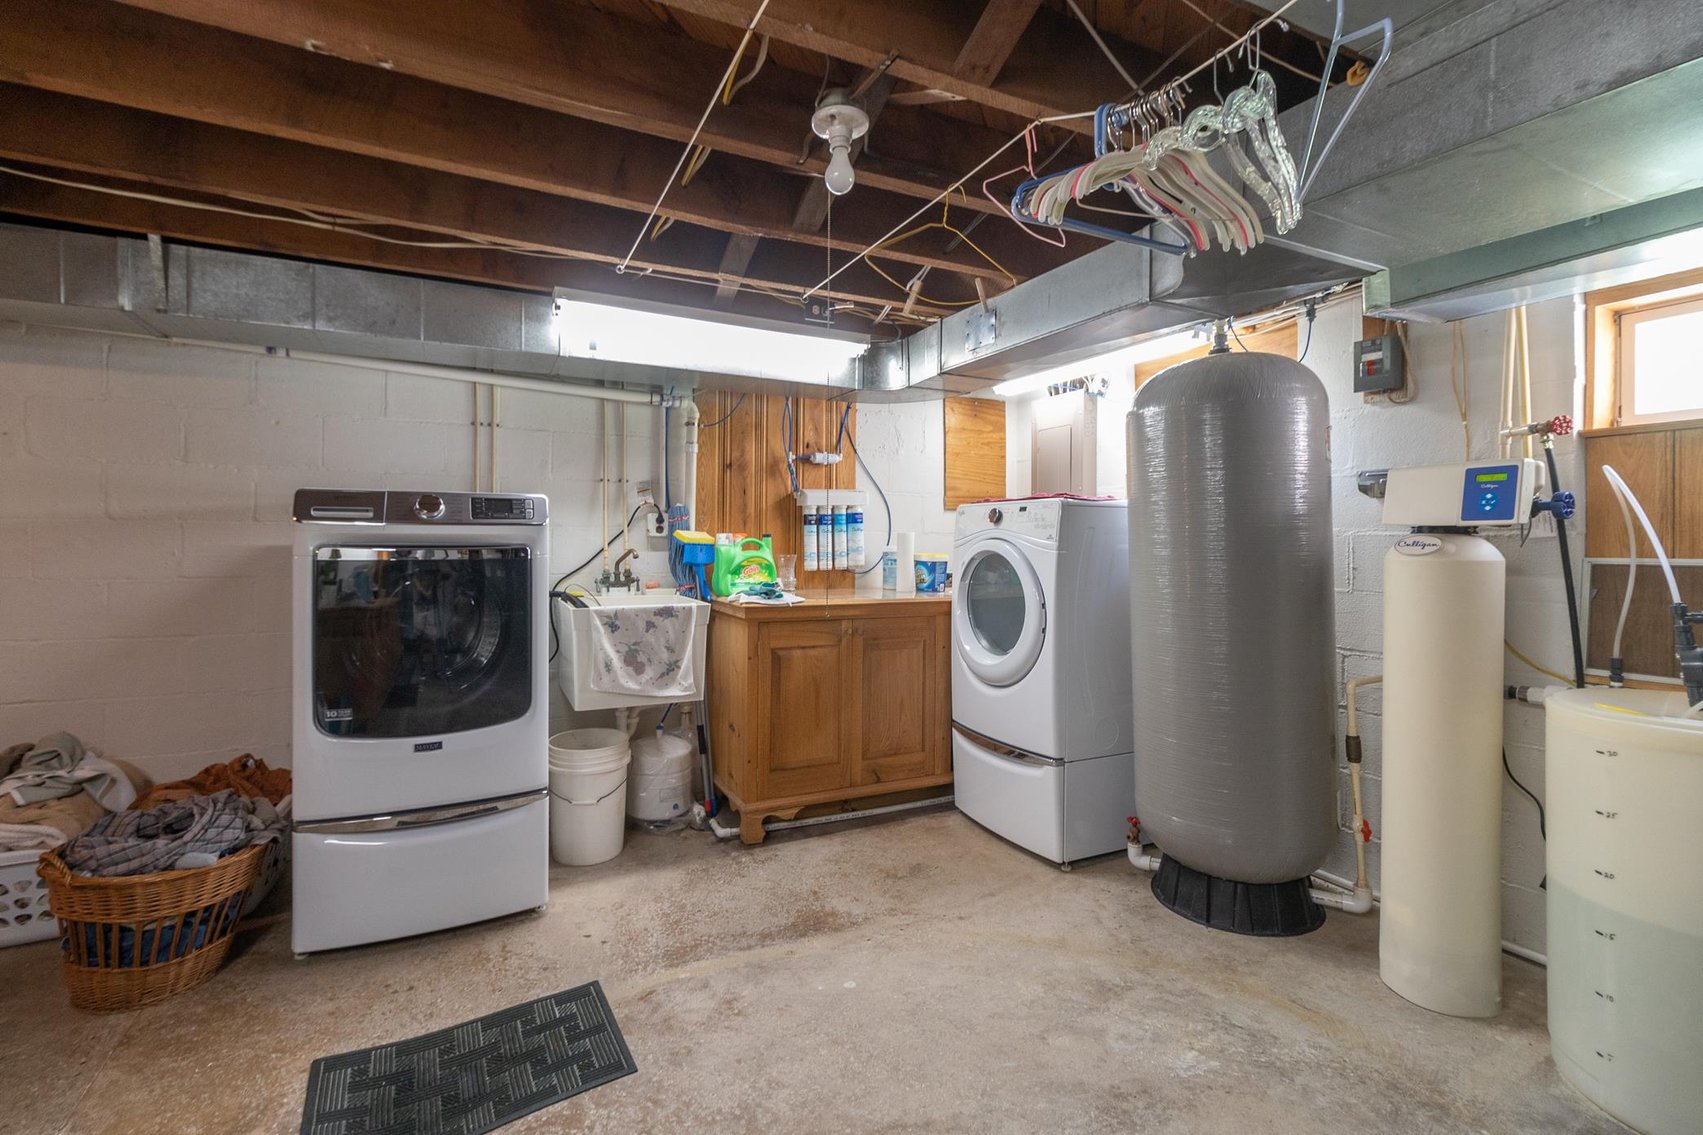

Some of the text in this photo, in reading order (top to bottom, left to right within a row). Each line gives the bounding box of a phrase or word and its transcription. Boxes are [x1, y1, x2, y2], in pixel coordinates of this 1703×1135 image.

[1397, 540, 1440, 550] Culligan
[742, 565, 760, 576] Gain
[326, 710, 337, 718] 10
[1605, 811, 1618, 819] 25
[1604, 872, 1615, 880] 20
